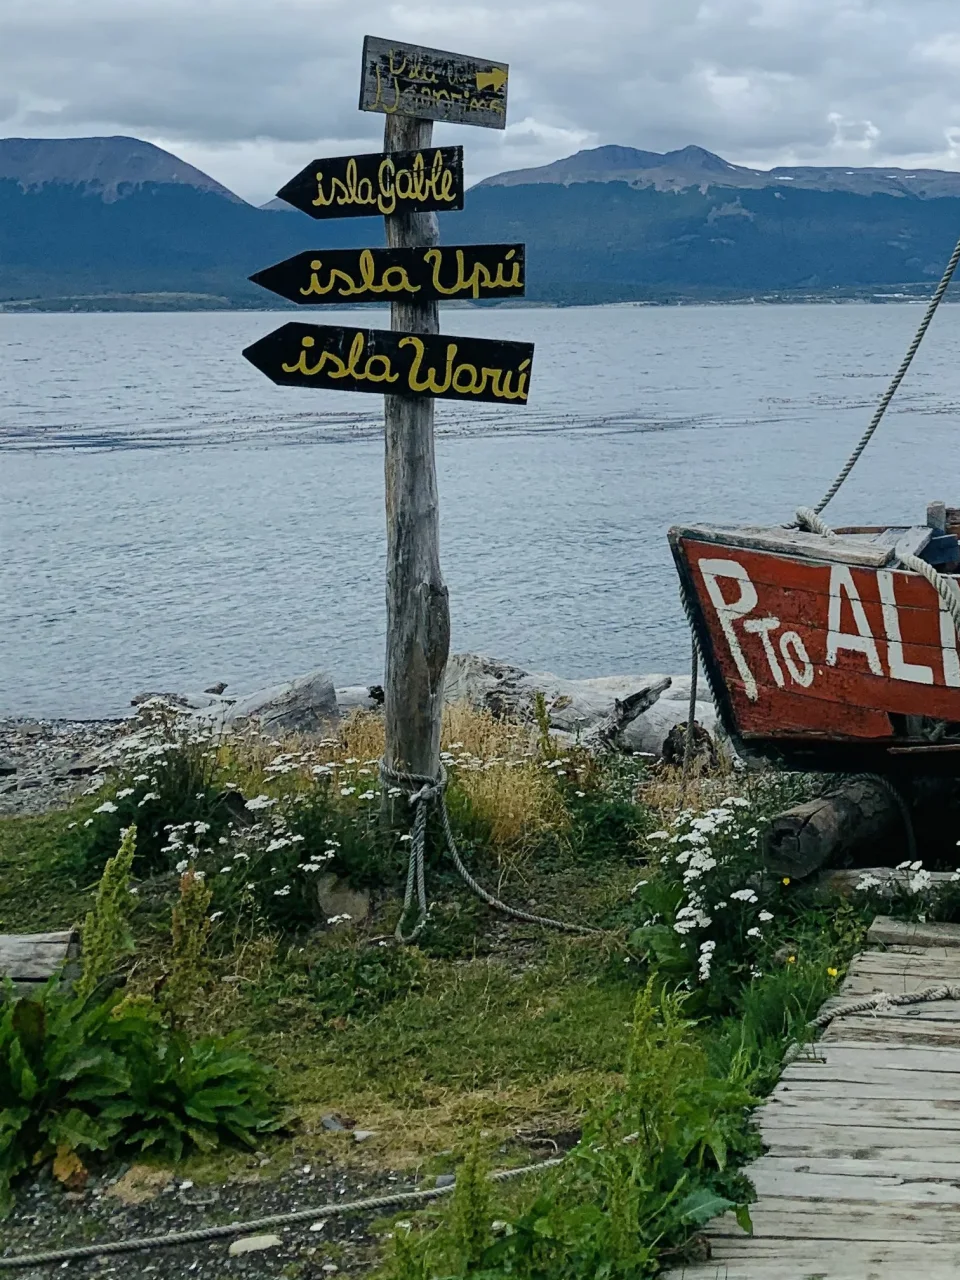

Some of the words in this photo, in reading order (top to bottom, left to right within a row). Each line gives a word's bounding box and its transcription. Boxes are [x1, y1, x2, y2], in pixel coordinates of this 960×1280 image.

[312, 158, 377, 206] isla
[377, 150, 457, 215] Gable
[300, 249, 421, 295] isla
[424, 248, 524, 299] Upú
[281, 332, 399, 382] isla
[398, 336, 530, 400] Warú
